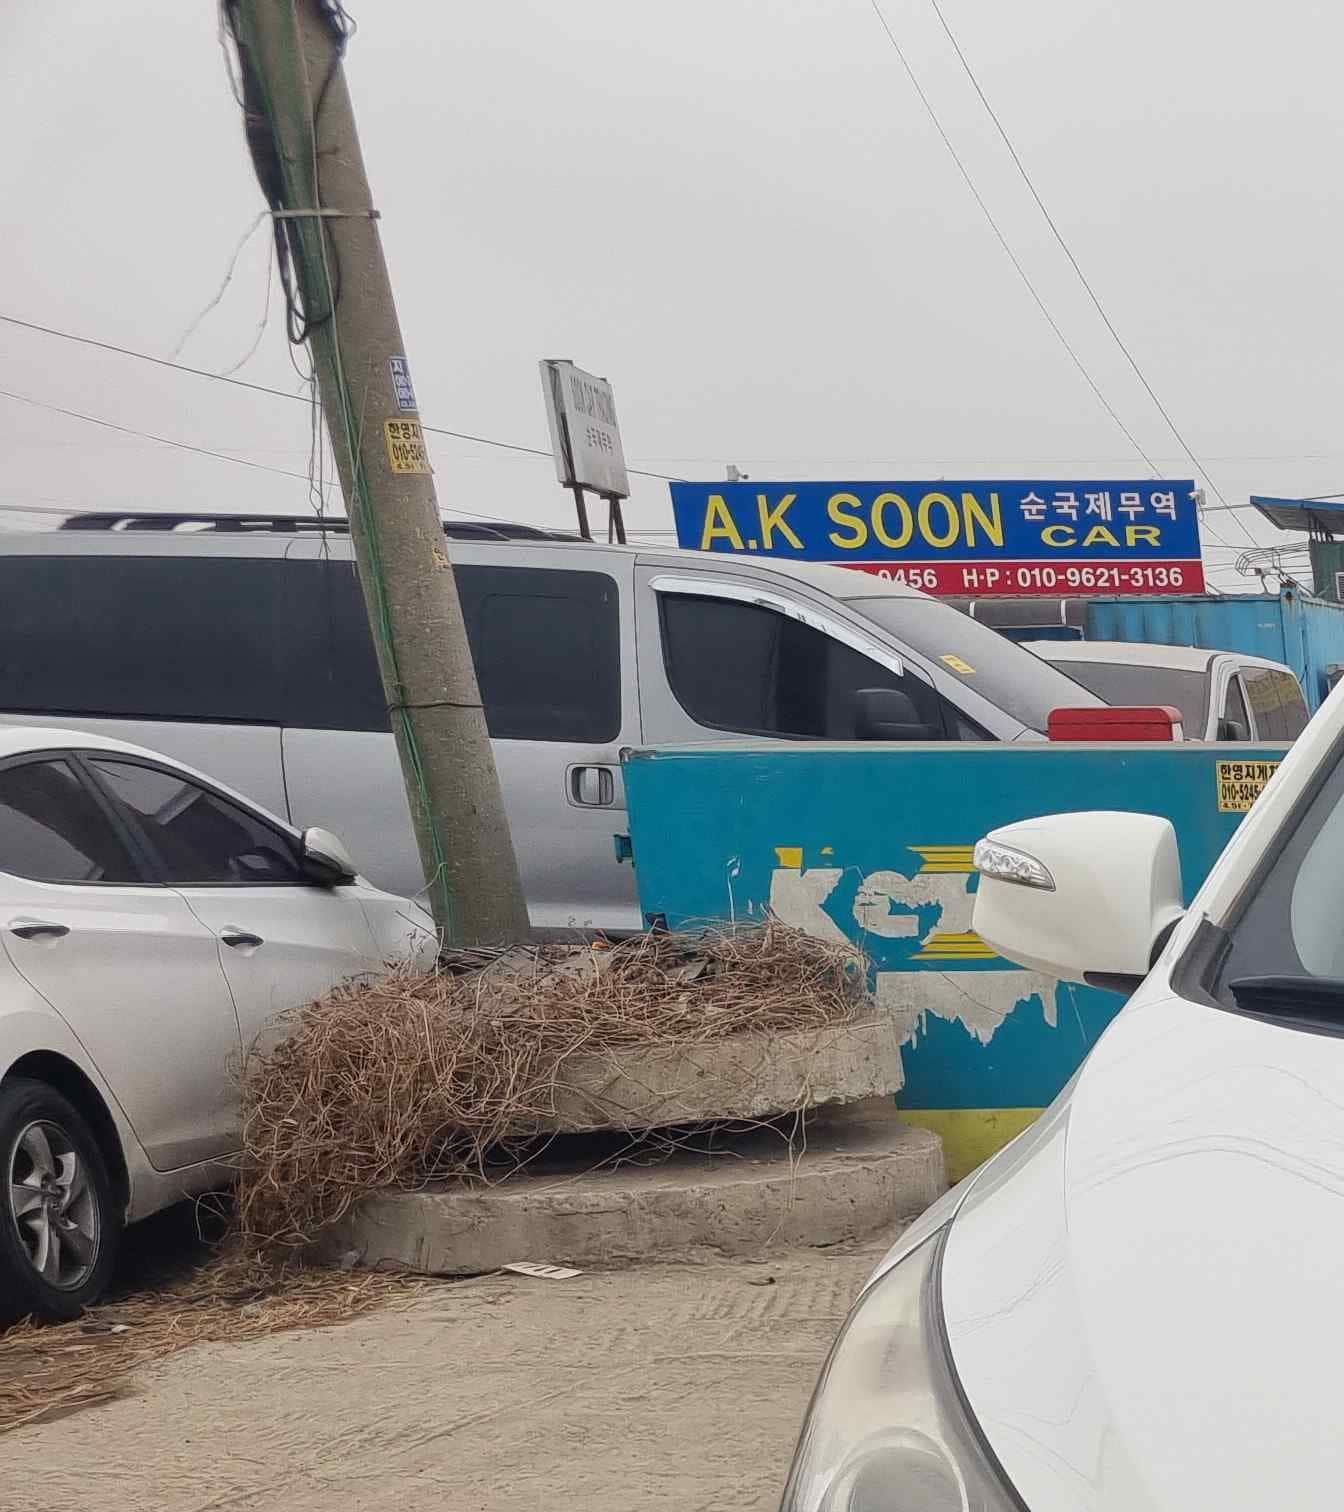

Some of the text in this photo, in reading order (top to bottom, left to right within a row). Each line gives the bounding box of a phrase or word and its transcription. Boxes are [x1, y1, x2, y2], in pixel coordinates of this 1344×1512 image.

[1019, 491, 1177, 521] 순국제무역
[700, 492, 1004, 550] A.K SOON
[1040, 525, 1161, 547] CAR
[1017, 567, 1184, 587] 010-9621-3136
[1221, 783, 1266, 801] 010-5245-
